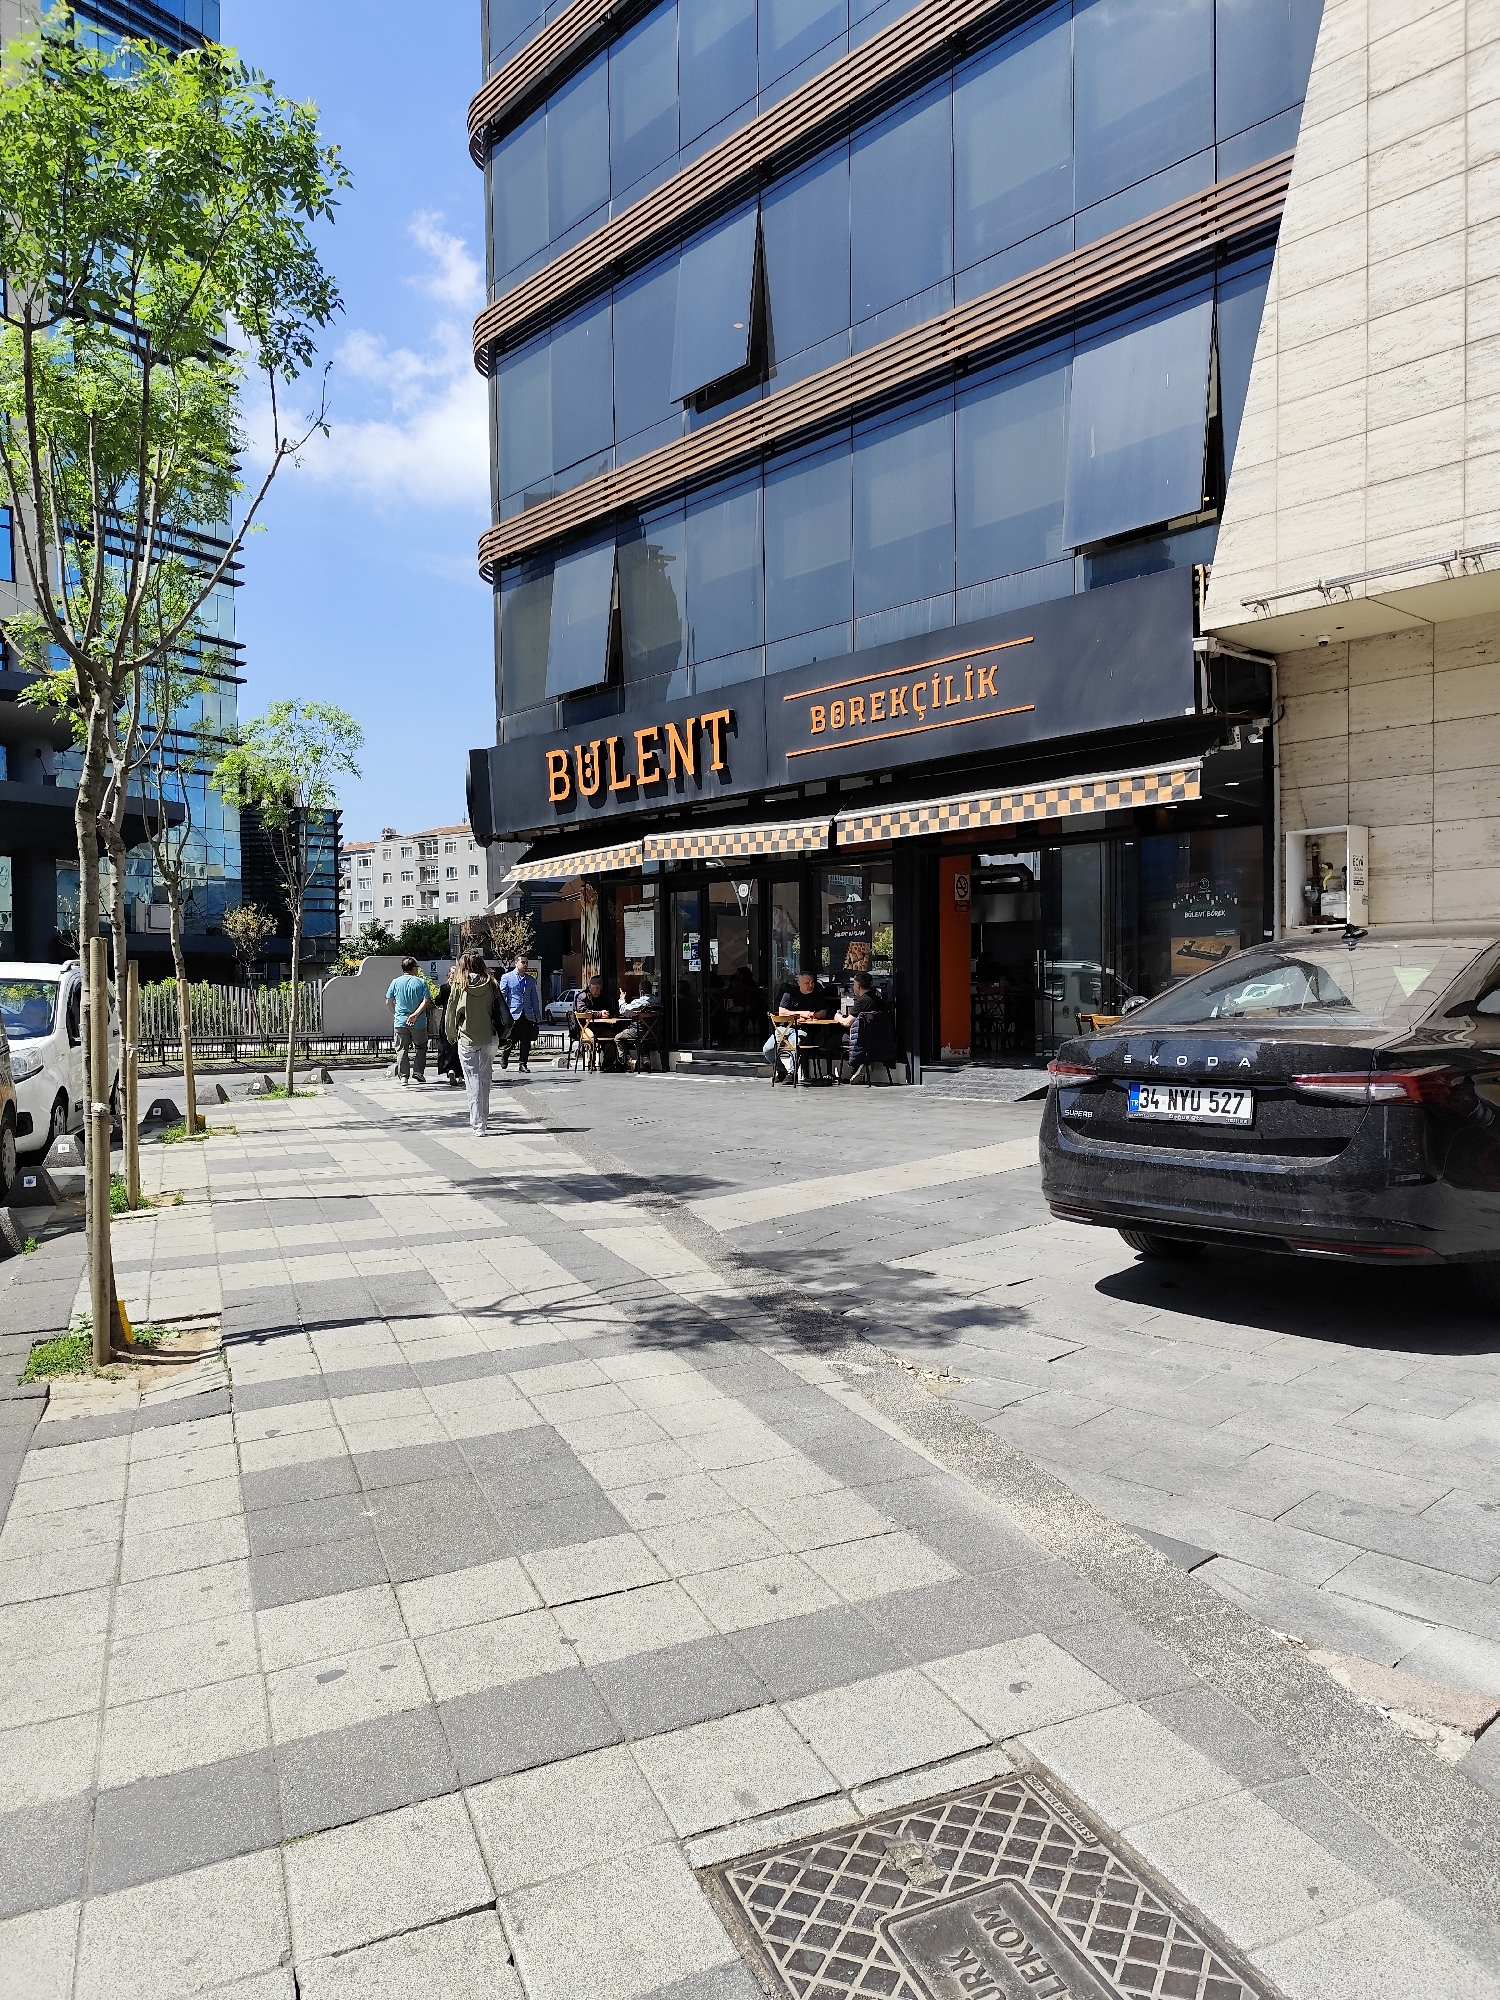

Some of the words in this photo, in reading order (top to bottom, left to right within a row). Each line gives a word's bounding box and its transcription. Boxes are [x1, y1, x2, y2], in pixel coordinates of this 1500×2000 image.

[810, 664, 998, 735] BÖREKÇİLİK
[545, 708, 731, 803] BÜLENT
[1064, 1109, 1094, 1119] SUPERB
[1130, 1099, 1139, 1108] TR
[1139, 1087, 1160, 1110] 34
[1167, 1088, 1202, 1112] NYU
[1208, 1091, 1245, 1115] 527
[974, 1904, 1077, 2000] LEKOM
